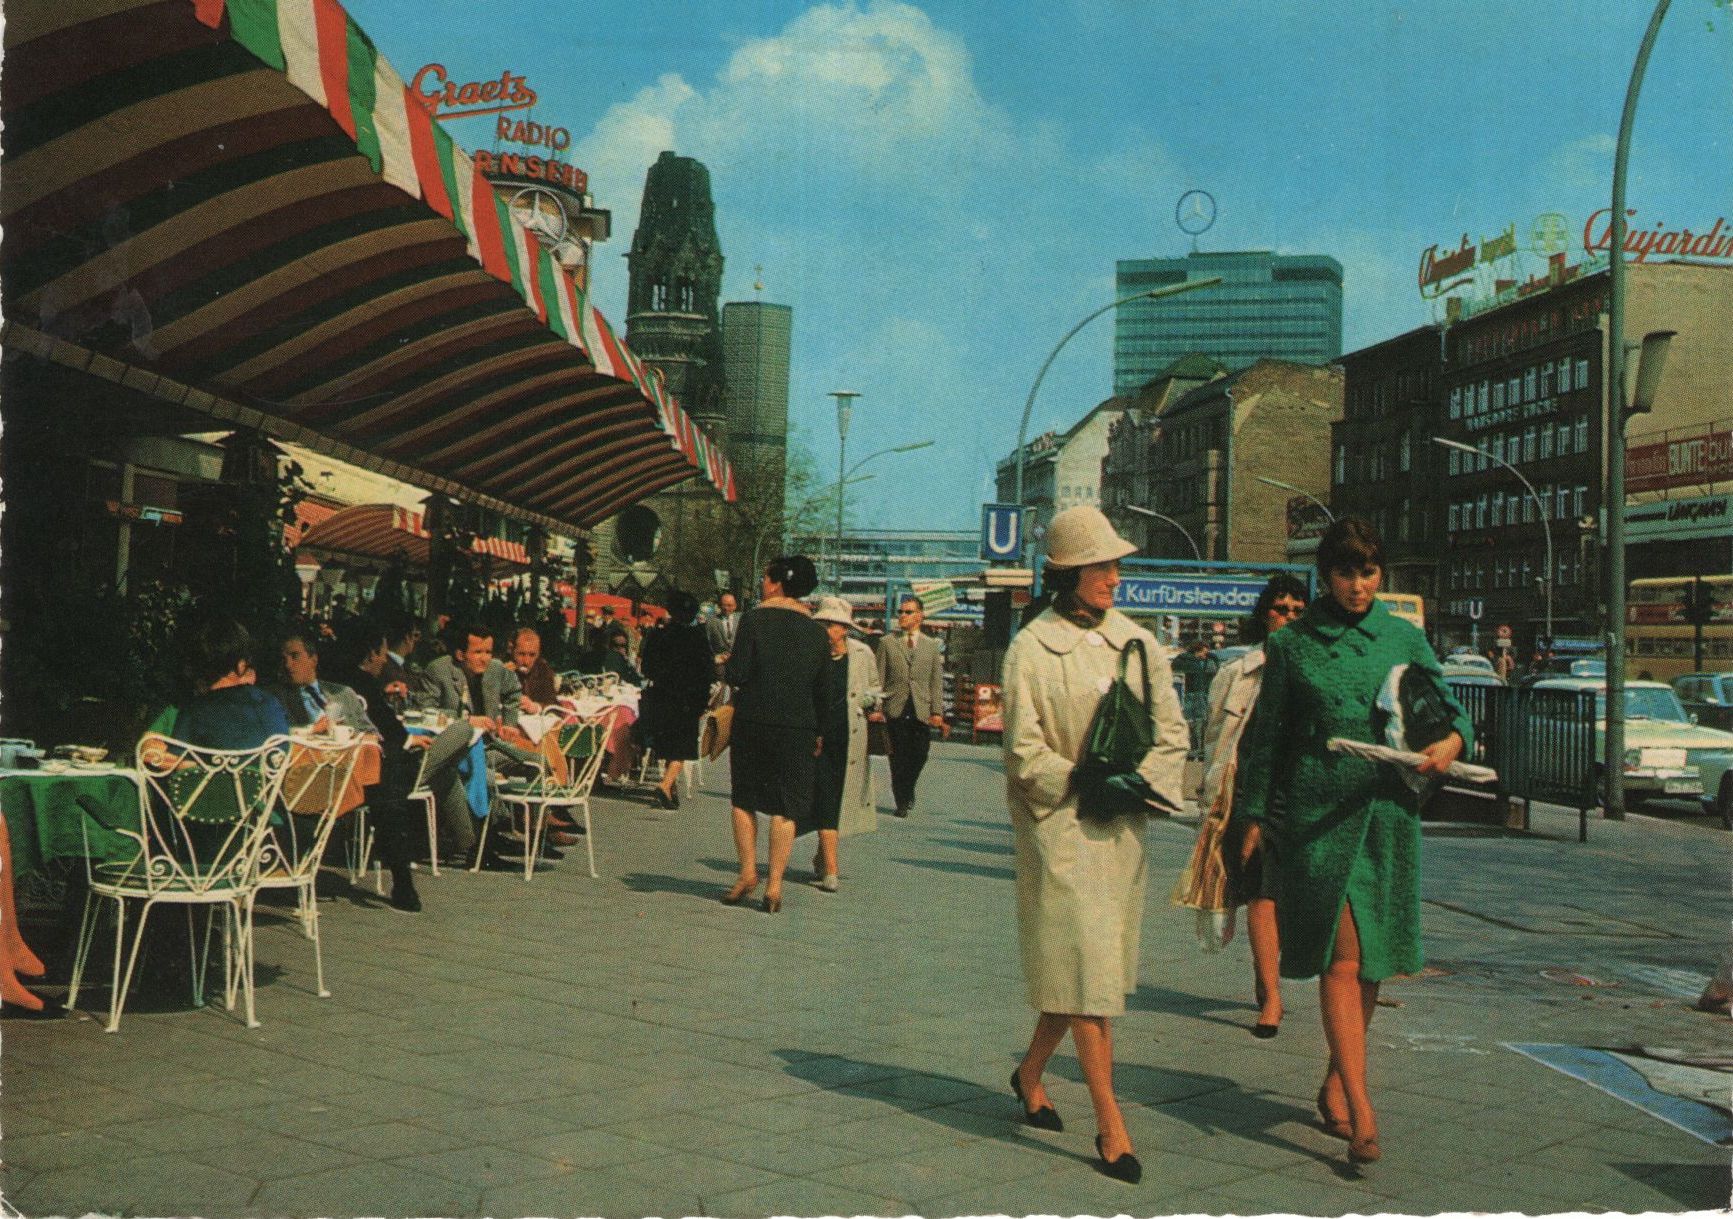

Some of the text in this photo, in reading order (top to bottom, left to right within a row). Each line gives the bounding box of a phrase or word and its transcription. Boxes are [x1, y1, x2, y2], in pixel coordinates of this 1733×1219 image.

[411, 63, 538, 120] Graetz
[498, 116, 571, 151] RADIO
[988, 511, 1018, 555] U
[1470, 601, 1483, 620] U
